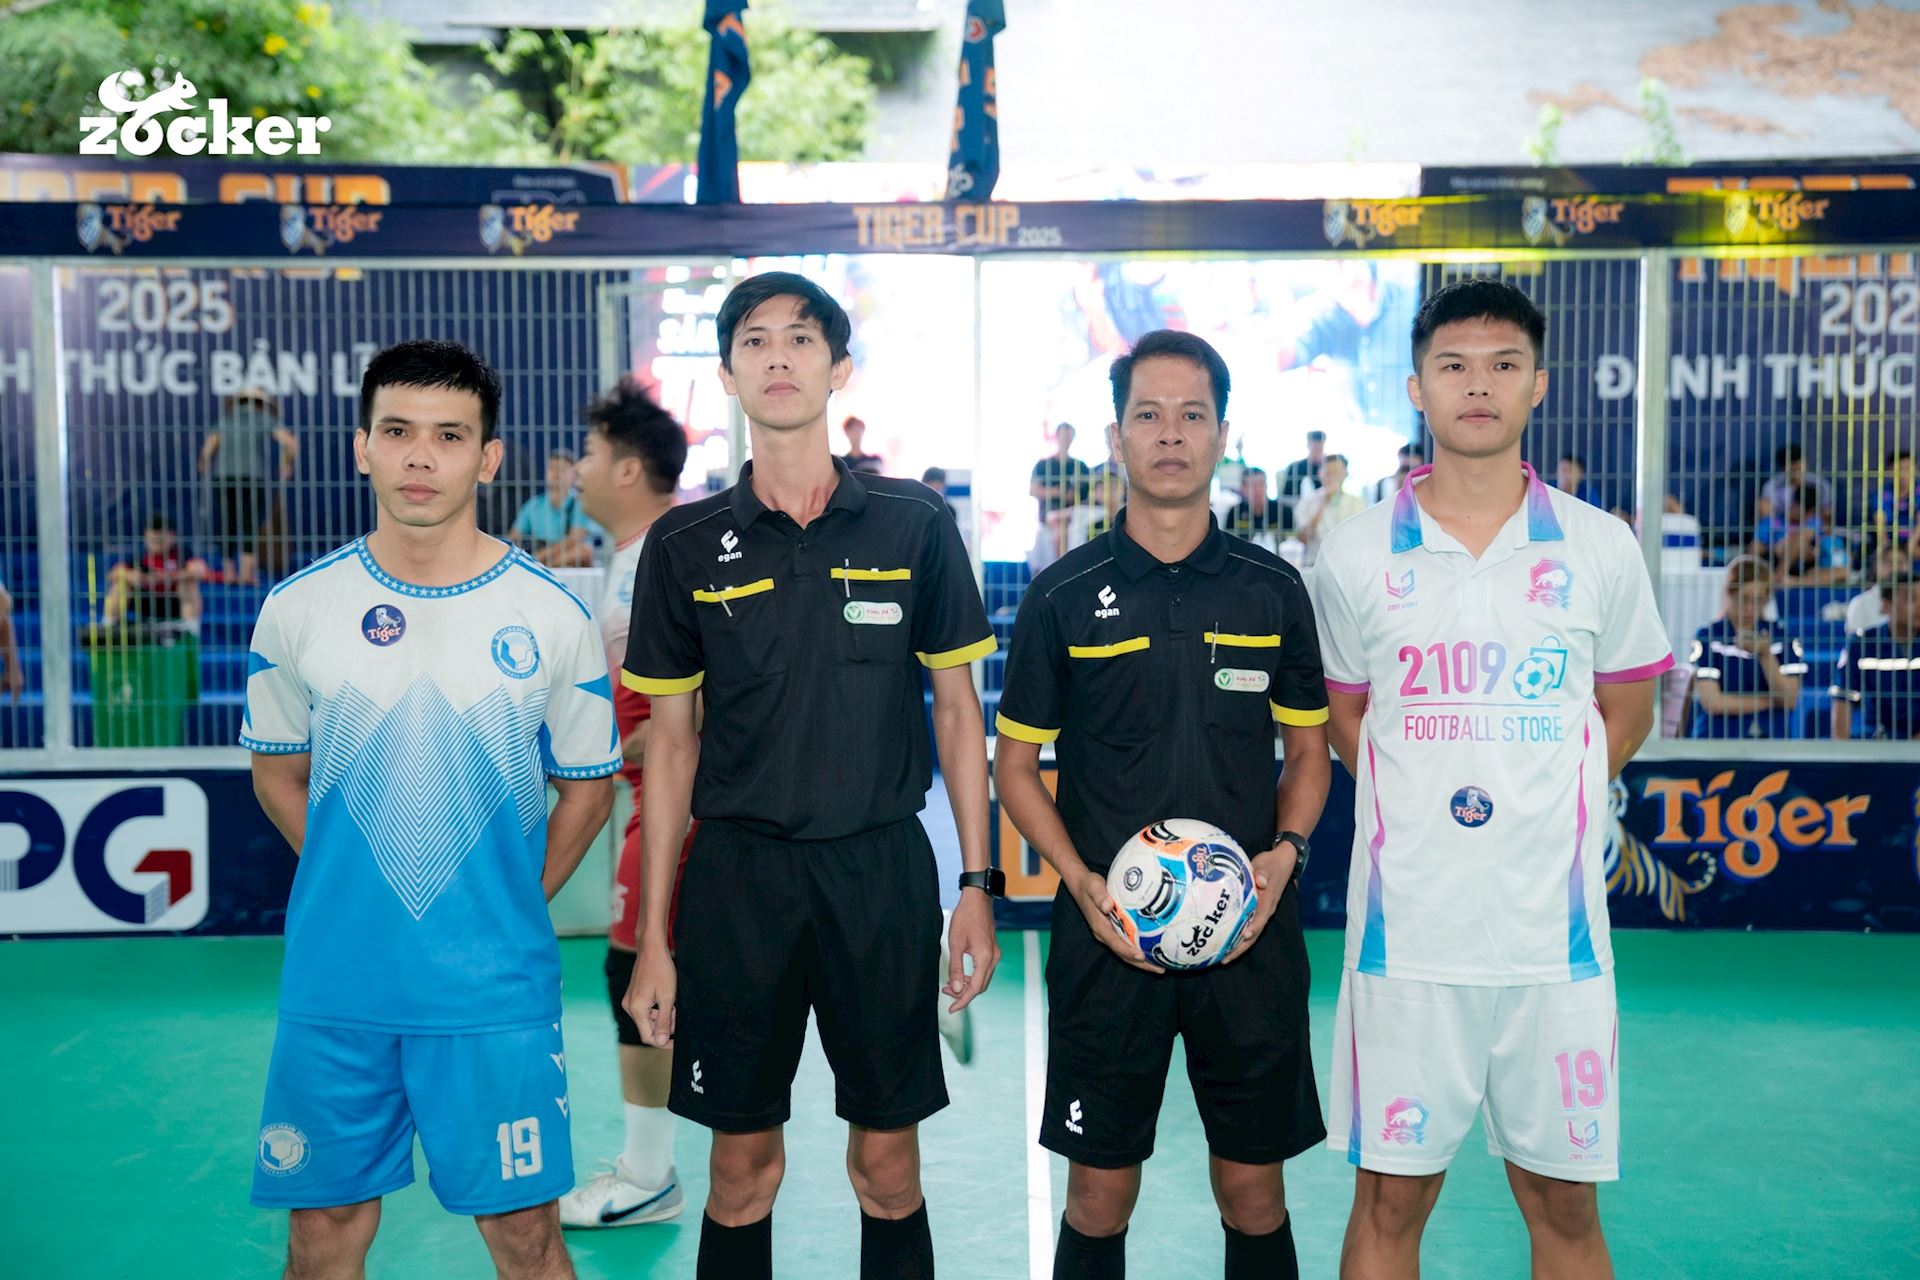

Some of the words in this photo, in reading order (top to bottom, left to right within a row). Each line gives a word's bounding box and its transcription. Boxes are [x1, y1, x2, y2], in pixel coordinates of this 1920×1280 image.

[105, 203, 182, 241] Tiger
[307, 203, 383, 242] Tiger
[508, 204, 580, 242] Tiger
[852, 205, 945, 249] TIGER
[955, 205, 1020, 246] CUP
[1017, 227, 1063, 247] 2025
[1350, 199, 1424, 237] Tiger
[1550, 195, 1625, 234] Tiger
[1753, 192, 1830, 231] Tiger
[98, 277, 236, 334] 2025
[1820, 281, 1920, 335] 202
[210, 337, 317, 397] BẢN
[1594, 354, 1750, 401] ĐNH
[1763, 340, 1917, 401] THỨC
[717, 550, 743, 563] egan
[1094, 607, 1120, 619] egan
[367, 625, 402, 643] Tiger
[1398, 640, 1507, 697] 2109
[1404, 714, 1496, 741] FOOTBALL
[1502, 715, 1564, 742] STORE
[1453, 804, 1488, 824] Tiger
[1643, 769, 1871, 880] Tiger
[1191, 846, 1209, 876] Tiger
[1186, 887, 1231, 957] zocker
[1553, 1049, 1609, 1111] 19
[495, 1116, 544, 1181] 19
